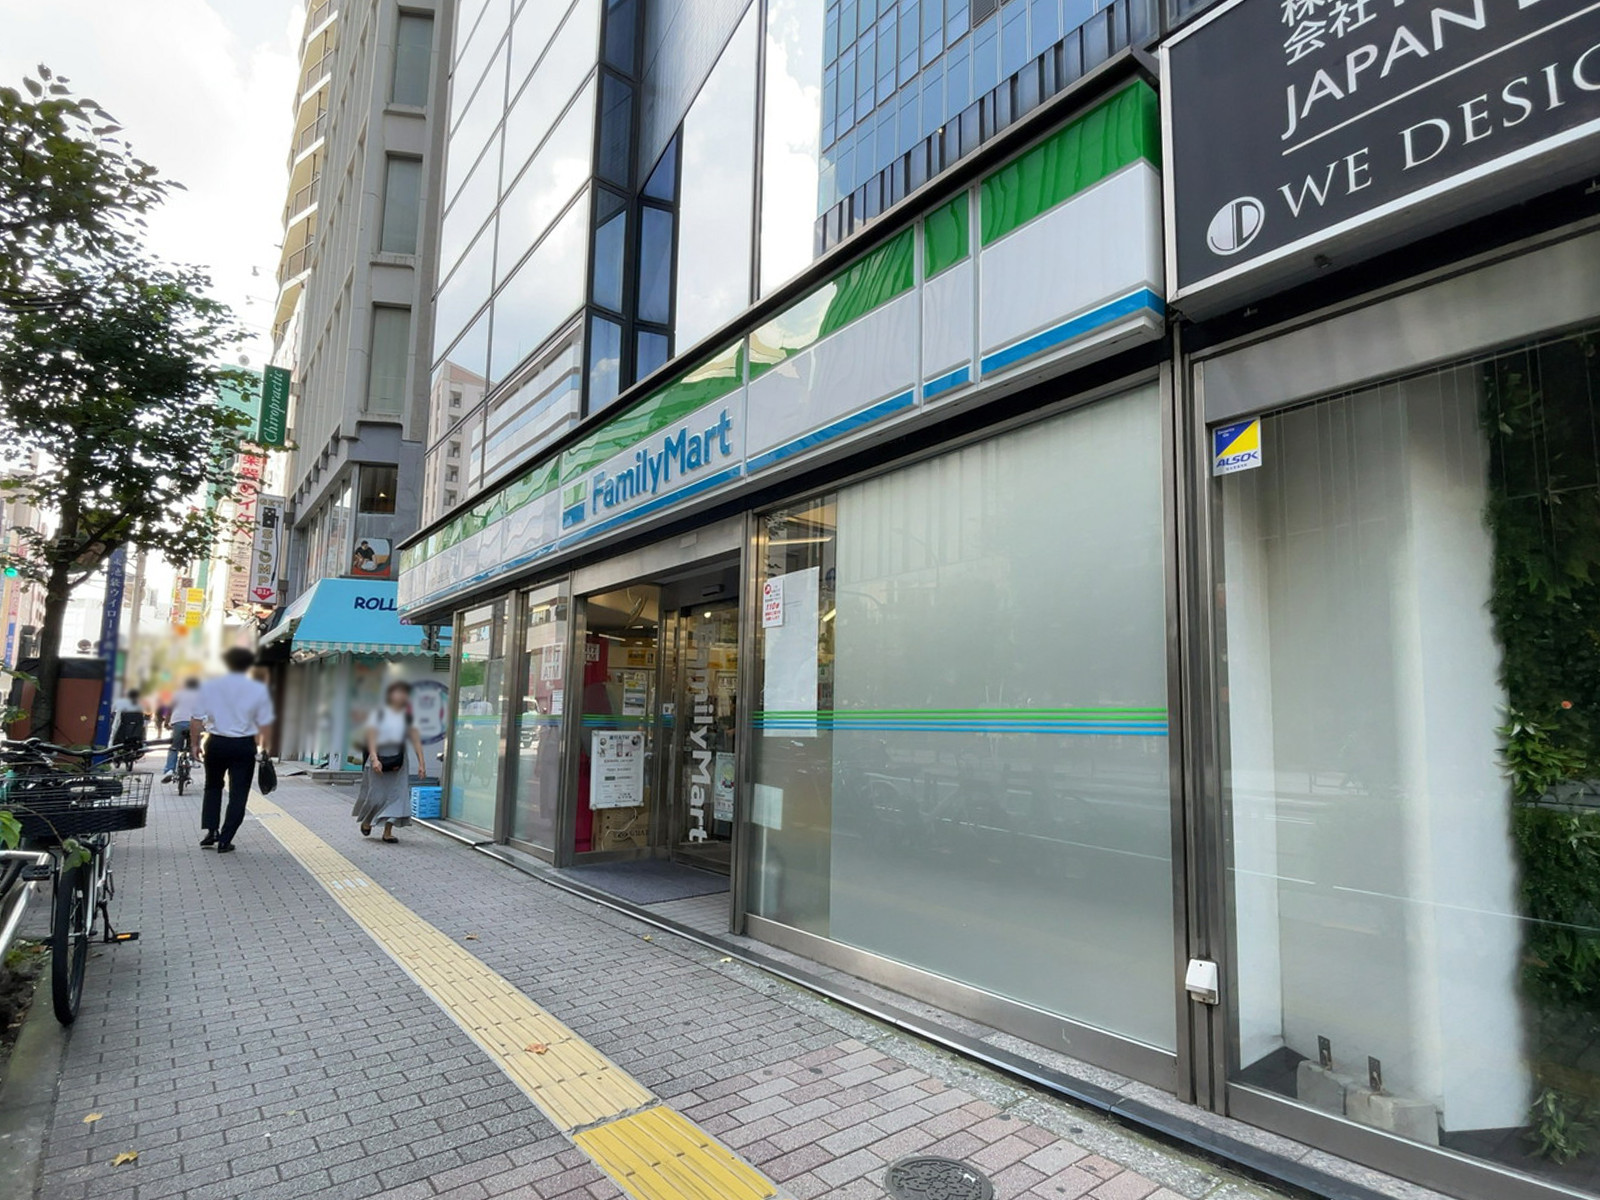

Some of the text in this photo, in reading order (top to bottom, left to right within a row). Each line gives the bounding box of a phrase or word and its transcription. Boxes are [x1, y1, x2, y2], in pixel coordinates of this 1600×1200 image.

[1282, 0, 1377, 66] 会社
[1281, 0, 1487, 140] JAPAN
[1277, 147, 1373, 219] WE
[263, 369, 285, 445] Chiropractic
[592, 407, 734, 516] FamilyMart
[1216, 450, 1259, 468] ALSOK
[259, 497, 284, 509] GET
[257, 528, 273, 586] STOMP
